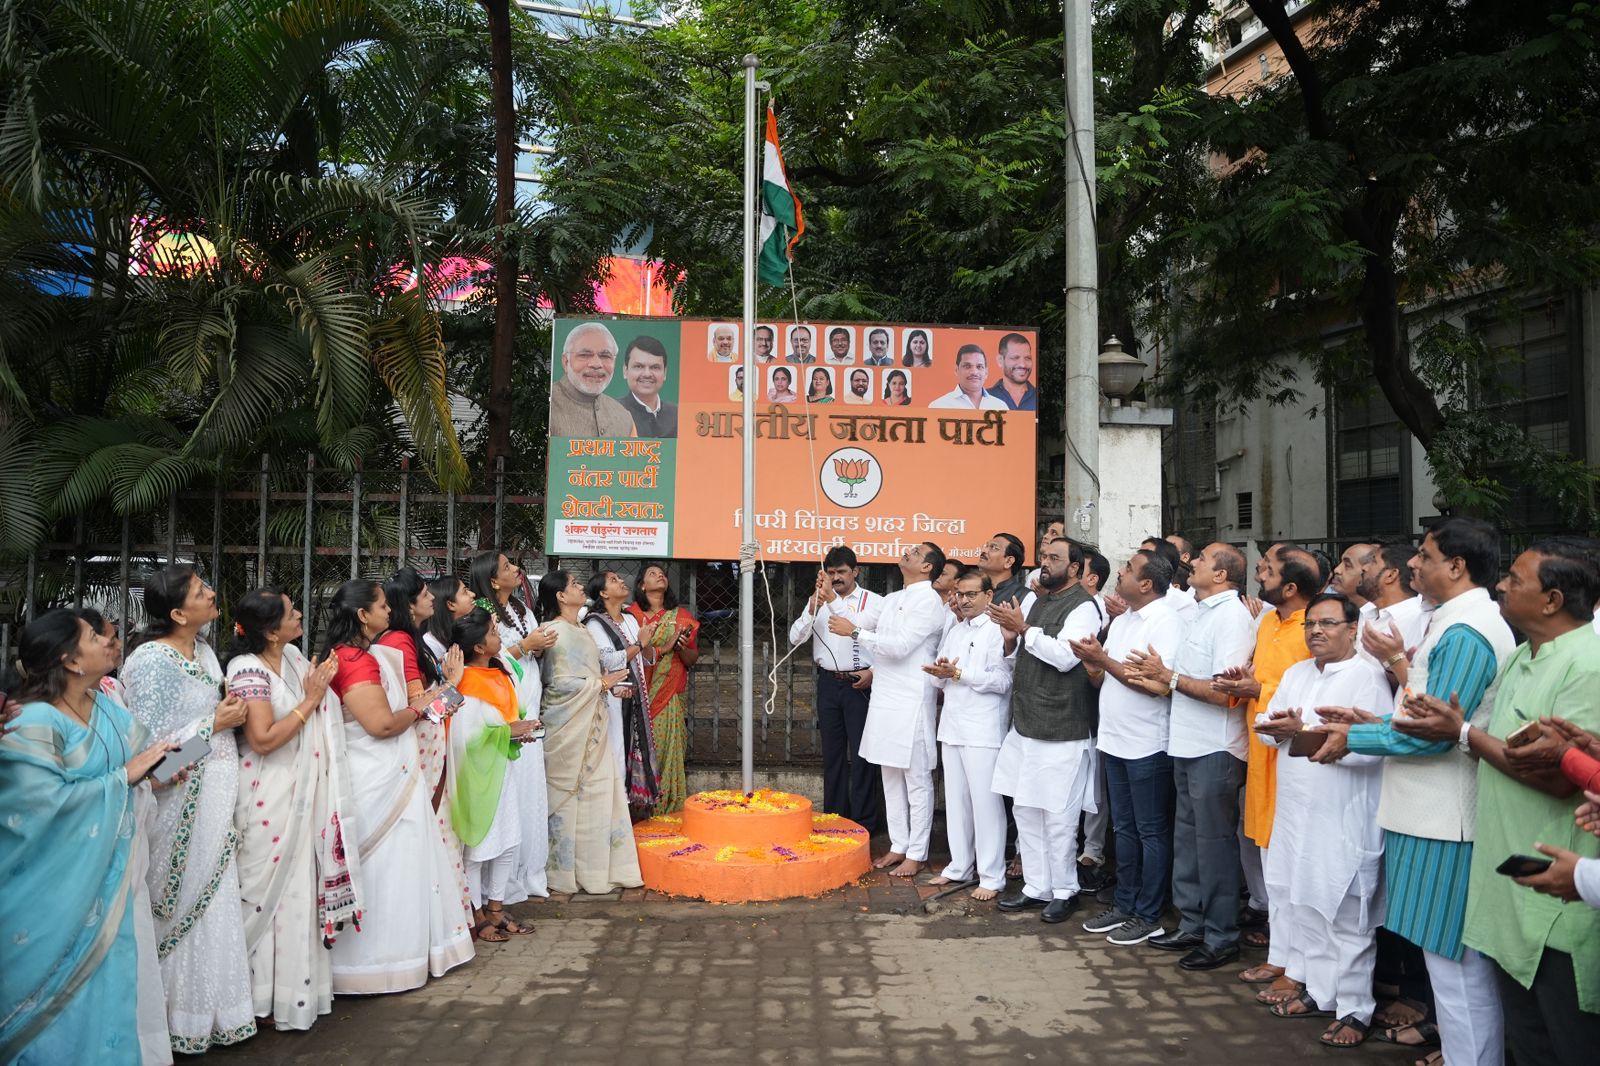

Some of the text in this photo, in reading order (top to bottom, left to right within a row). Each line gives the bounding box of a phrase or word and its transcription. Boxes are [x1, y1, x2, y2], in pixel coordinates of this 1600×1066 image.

[829, 413, 928, 444] जनता
[938, 410, 1009, 447] पार्टी
[567, 439, 662, 463] प्रथम राष्ट्र
[567, 465, 659, 488] नंतर पार्टी
[561, 494, 613, 518] शेवटी
[564, 522, 589, 536] शंकर
[623, 526, 658, 536] जगताप
[794, 509, 859, 531] चिंचवड
[865, 515, 906, 533] शहर
[912, 512, 967, 534] जिल्हा
